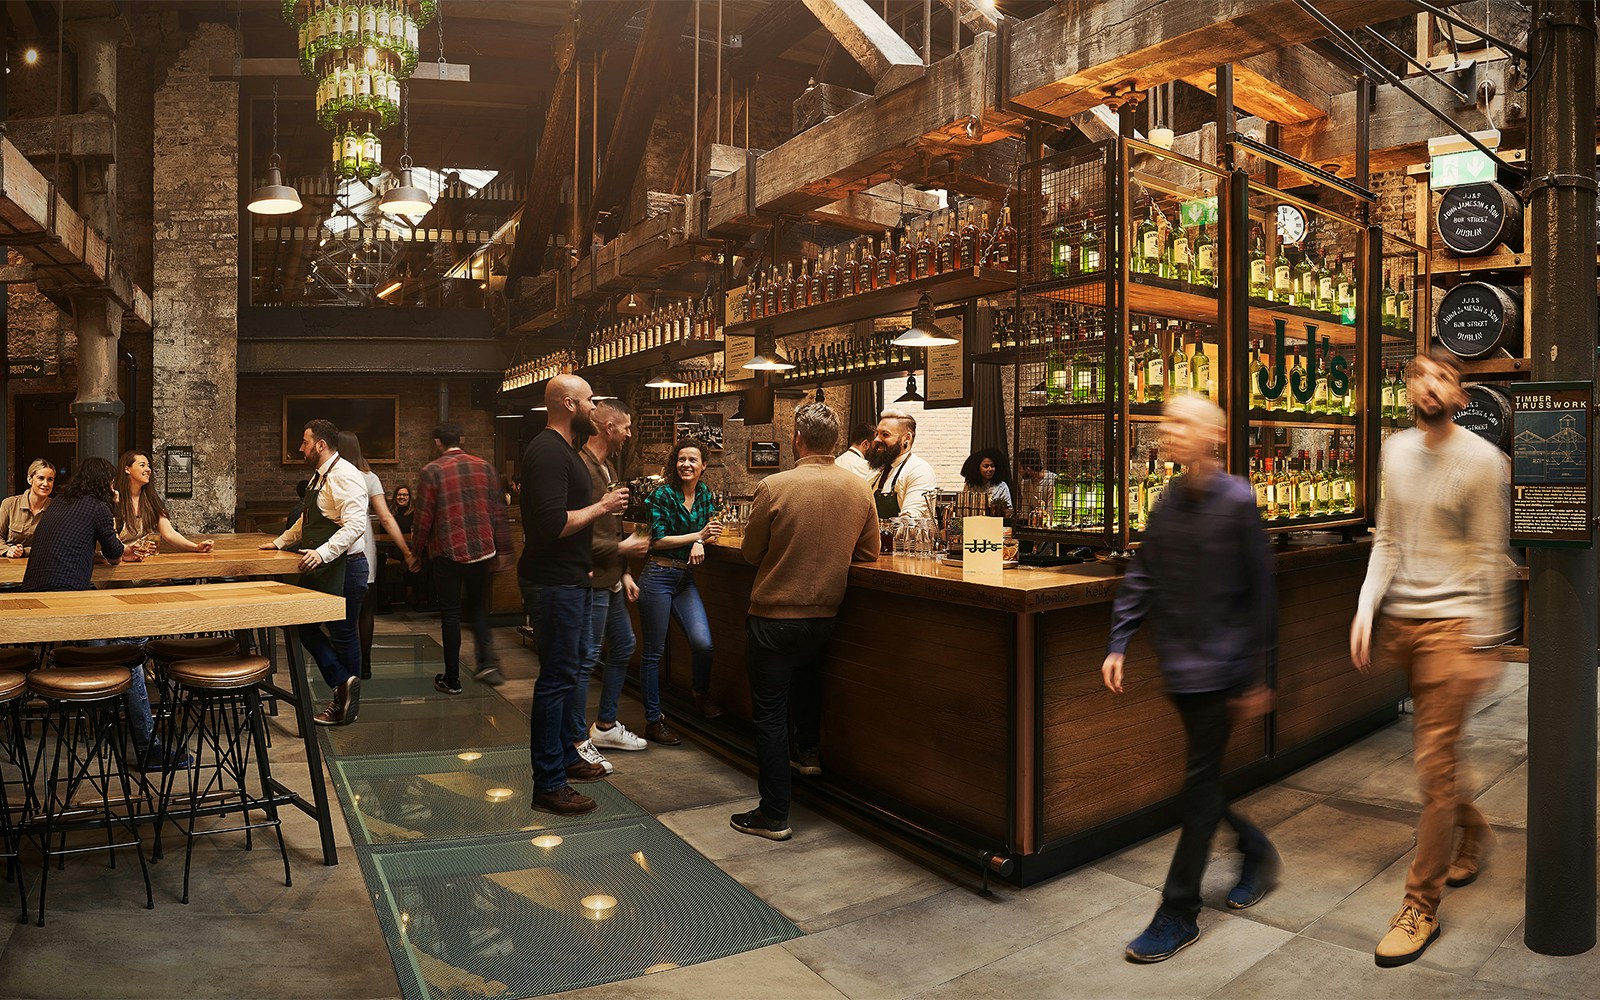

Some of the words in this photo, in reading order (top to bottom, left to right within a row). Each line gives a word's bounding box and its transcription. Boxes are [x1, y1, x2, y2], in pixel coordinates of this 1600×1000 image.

[1443, 206, 1458, 220] JOHN
[1457, 200, 1485, 210] JAMESON
[1488, 204, 1500, 218] SON
[1455, 227, 1482, 237] DUBLIN
[1442, 310, 1457, 325] JOHN
[1487, 309, 1500, 323] SON
[1456, 332, 1483, 341] DUBLIN
[1257, 316, 1349, 404] JJ's
[1515, 395, 1552, 403] TIMBER
[1515, 401, 1587, 409] TRUSSWORK
[968, 539, 998, 553] JJ's
[1035, 590, 1070, 605] Monks
[1085, 583, 1110, 599] Kelly
